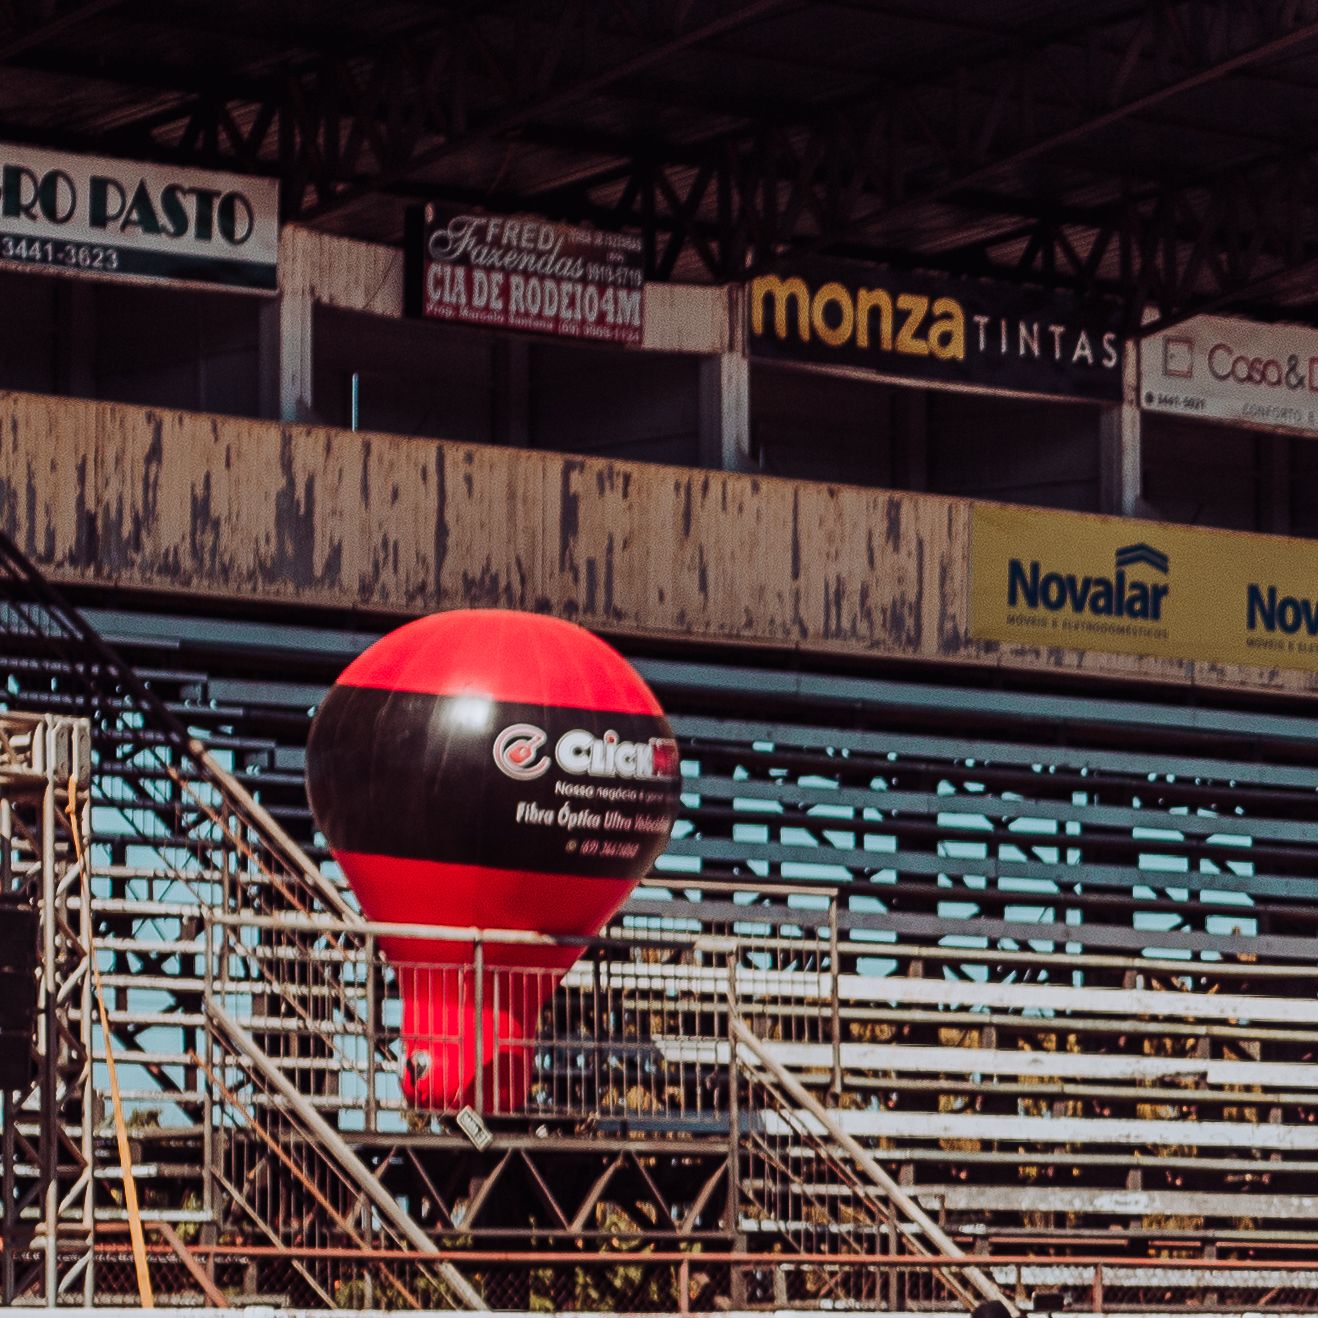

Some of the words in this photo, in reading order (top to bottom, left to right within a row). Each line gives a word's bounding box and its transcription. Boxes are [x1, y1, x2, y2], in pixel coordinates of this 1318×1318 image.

[0, 163, 76, 225] RO
[89, 176, 253, 246] PASTO
[429, 215, 585, 280] Fazendas
[487, 218, 554, 250] FRED
[426, 261, 468, 305] CIA
[473, 270, 504, 311] DE
[751, 274, 965, 361] monza
[973, 315, 1121, 368] TINTAS
[1007, 558, 1169, 622] Novalar
[516, 801, 555, 825] Fibra
[557, 800, 600, 831] Óptica
[603, 810, 633, 831] Ultra
[555, 780, 594, 798] Nosso
